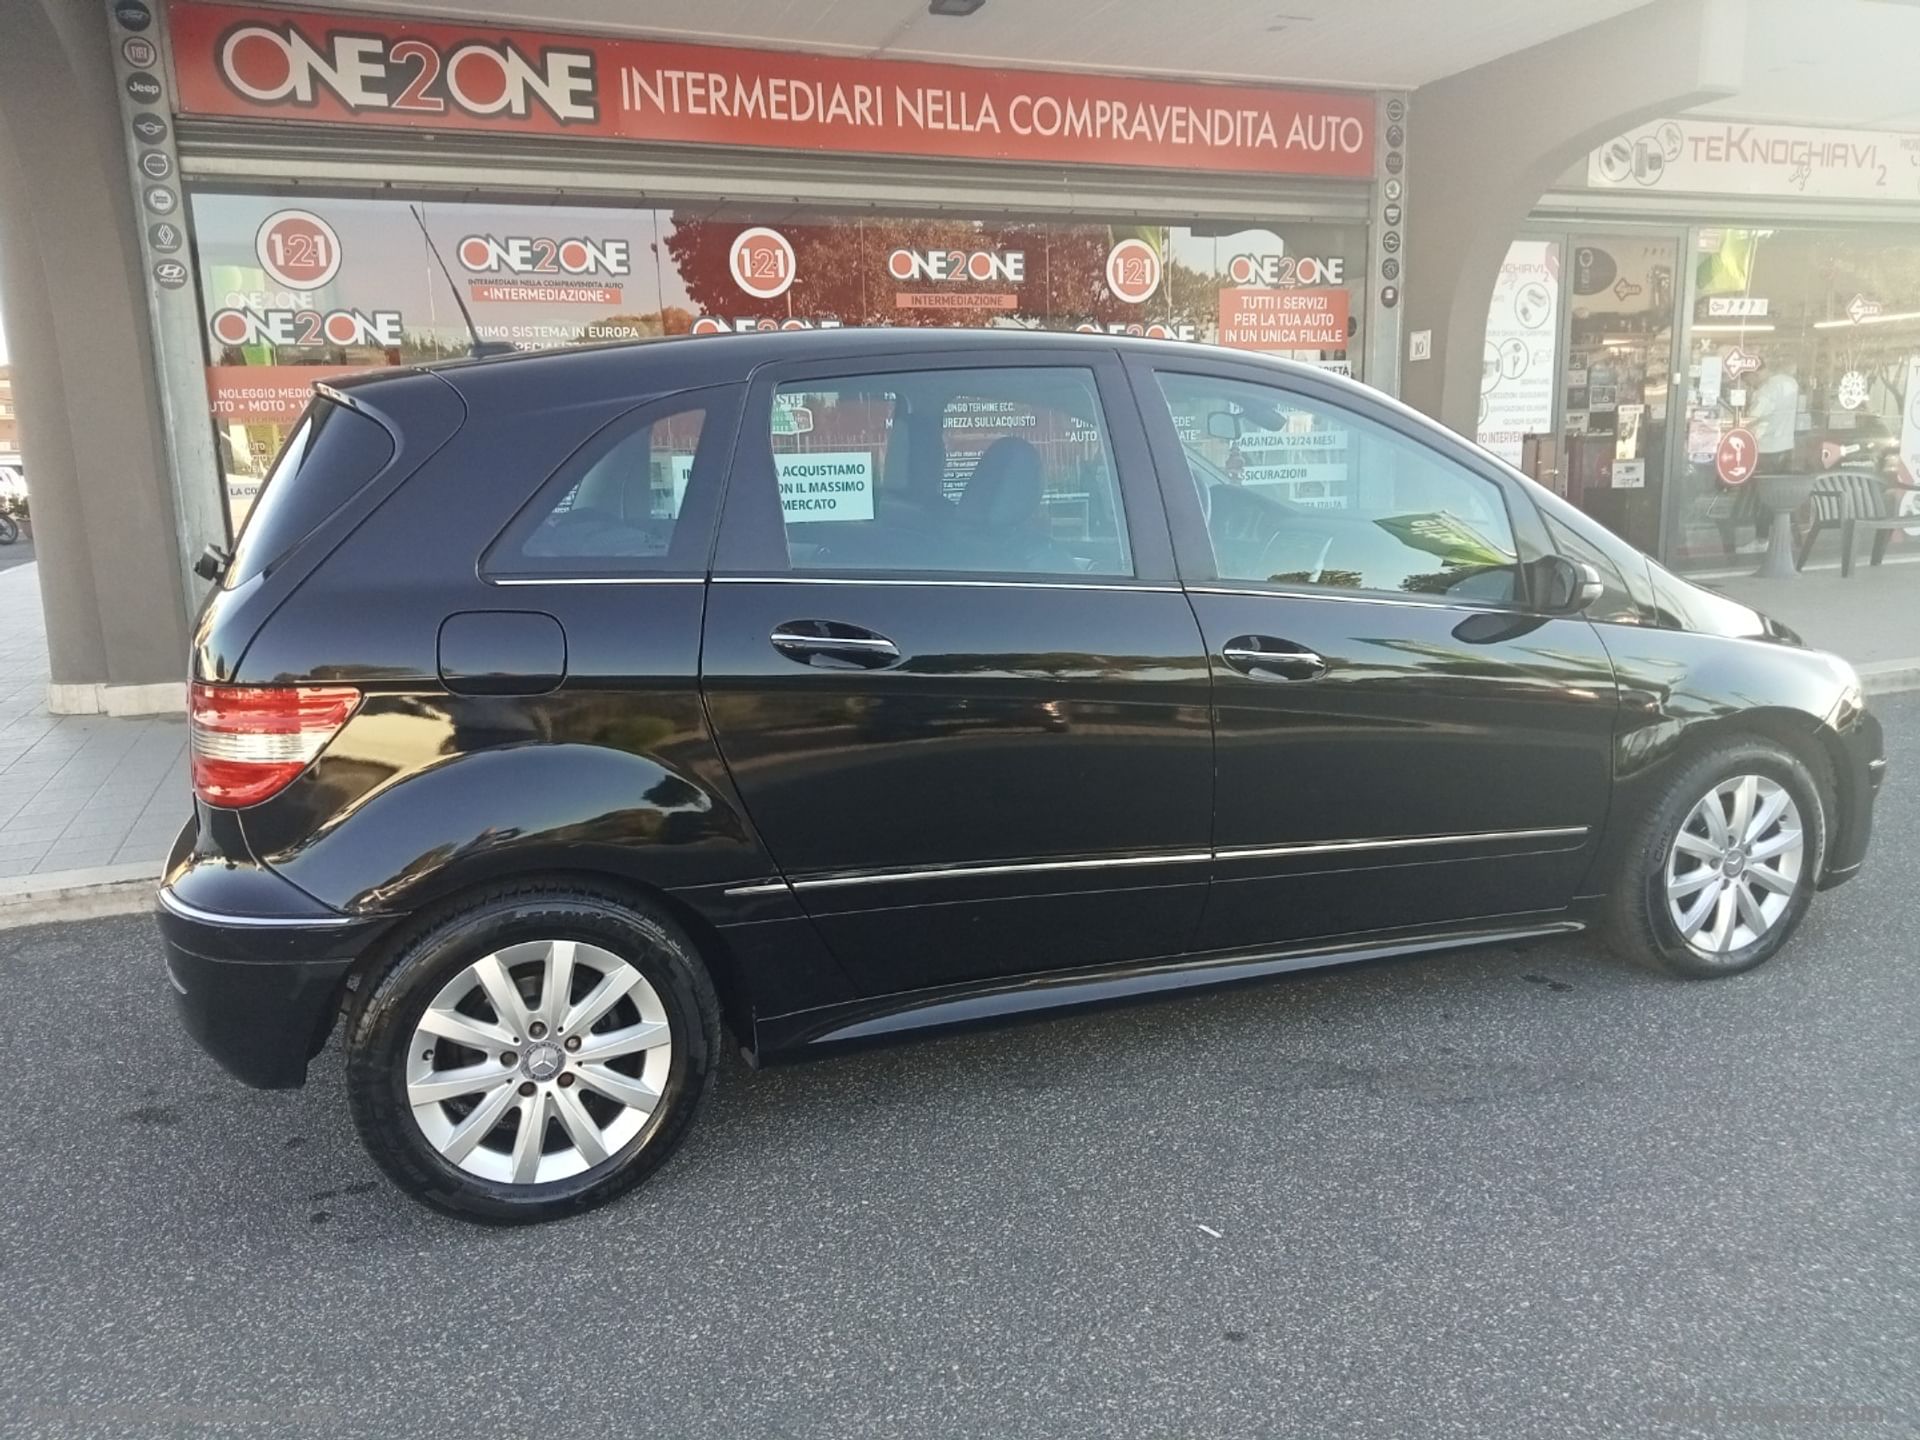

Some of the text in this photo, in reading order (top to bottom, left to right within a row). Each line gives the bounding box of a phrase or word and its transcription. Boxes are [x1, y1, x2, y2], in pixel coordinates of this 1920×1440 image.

[221, 26, 597, 120] ONE2ONE
[129, 81, 160, 95] Jeep
[620, 66, 1364, 154] INTERMEDIARI NELLA COMPRAVENDITA AUTO
[459, 236, 629, 275] ONE2ONE
[889, 249, 1024, 282] ONE2ONE
[1230, 254, 1344, 285] ONE2ONE
[489, 287, 605, 303] INTERMEDIAZIONE
[911, 294, 1004, 307] INTERMEDIAZIONE
[1241, 296, 1277, 309] TUTTI
[1284, 296, 1328, 310] SERVIZI
[213, 308, 402, 346] ONE2ONE
[1234, 313, 1334, 327] PER LA TUA AUTO
[511, 326, 570, 338] SISTEMA
[572, 326, 586, 338] IN
[588, 326, 639, 339] EUROPA
[1225, 329, 1343, 343] IN UN UNICA FILIALE
[218, 388, 276, 400] NOLEGGIO
[248, 400, 286, 412] MOTO
[1313, 435, 1337, 446] MESI
[782, 463, 866, 477] ACQUISTIAMO
[230, 487, 243, 496] LA
[796, 482, 807, 494] IL
[808, 480, 865, 493] MASSIMO
[782, 499, 837, 511] MERCATO
